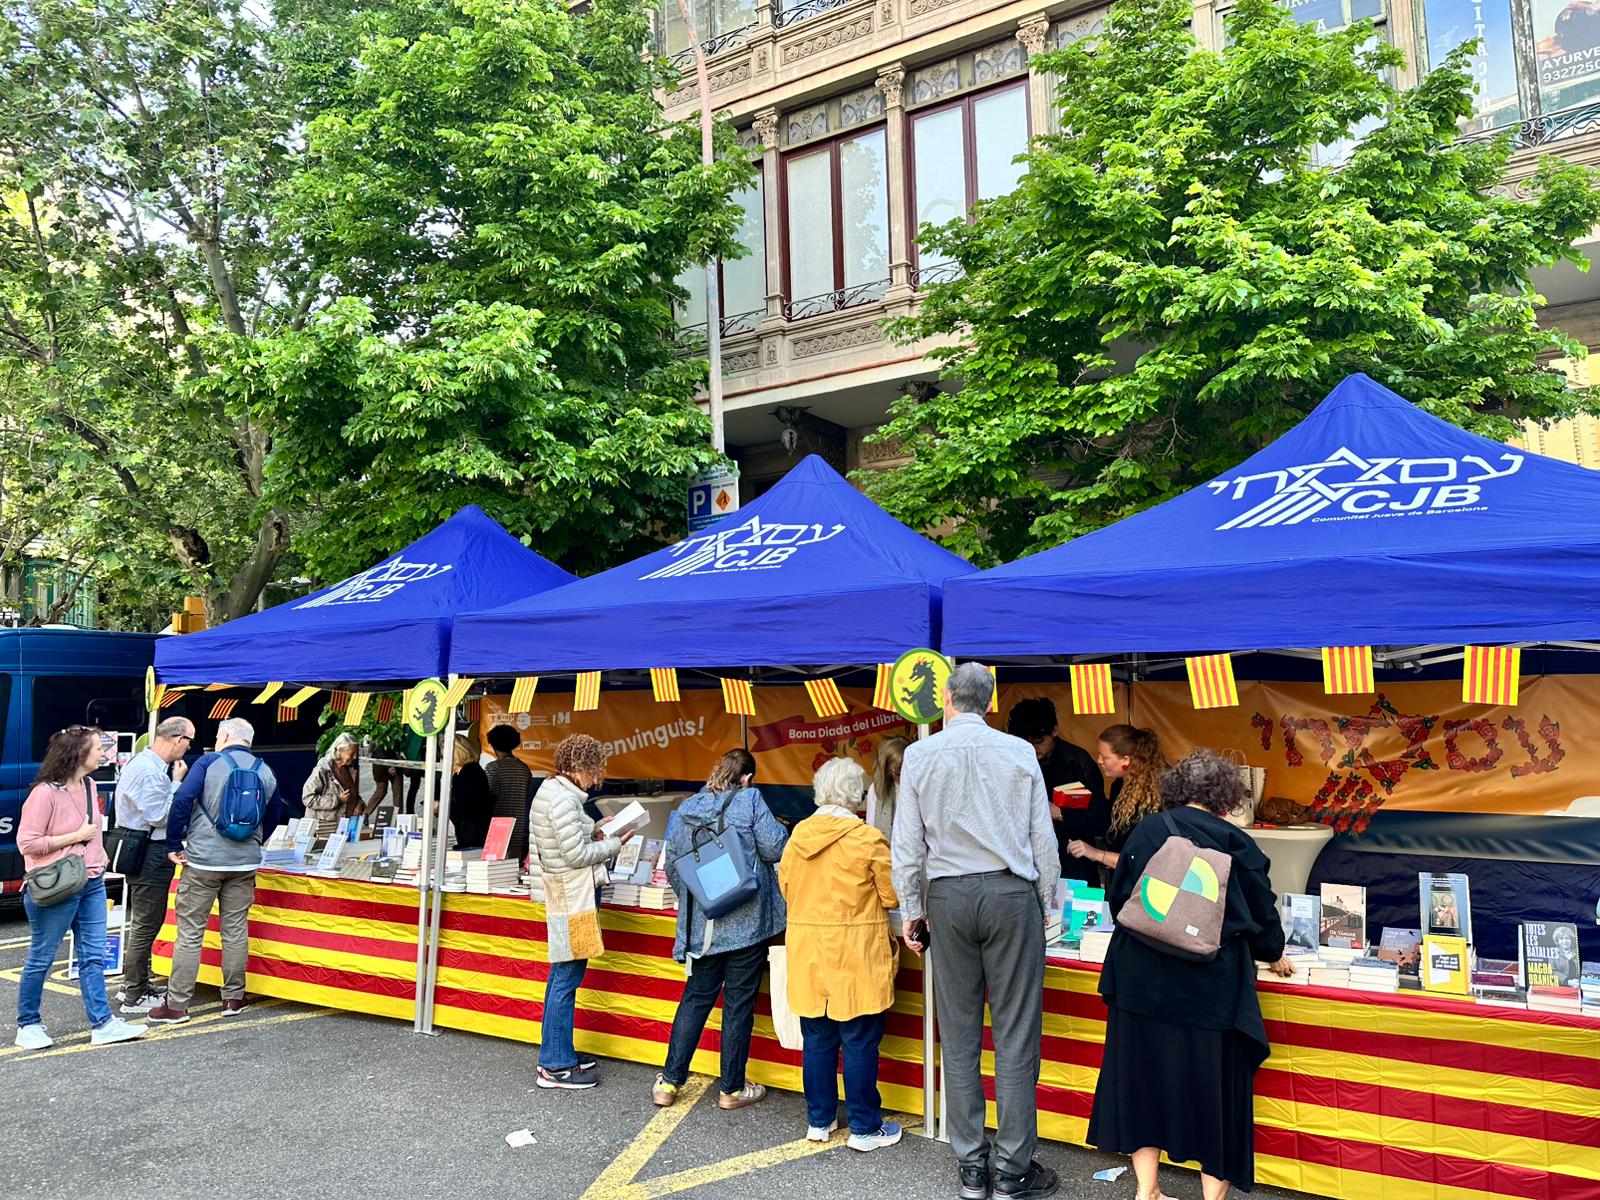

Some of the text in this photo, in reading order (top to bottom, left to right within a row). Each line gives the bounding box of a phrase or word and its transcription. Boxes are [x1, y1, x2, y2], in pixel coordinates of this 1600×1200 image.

[693, 490, 706, 515] P
[1342, 485, 1481, 513] CJB
[1312, 514, 1370, 523] Comunitat
[1426, 506, 1489, 515] Barcelona
[714, 547, 798, 569] CJB
[343, 583, 406, 601] CJB
[788, 713, 903, 740] Bona Diada del Llibre
[600, 715, 705, 757] envinguts!
[1525, 923, 1546, 936] TOTES
[1526, 934, 1539, 947] LES
[1526, 946, 1560, 959] BATALLES
[1528, 961, 1553, 975] MAGDA
